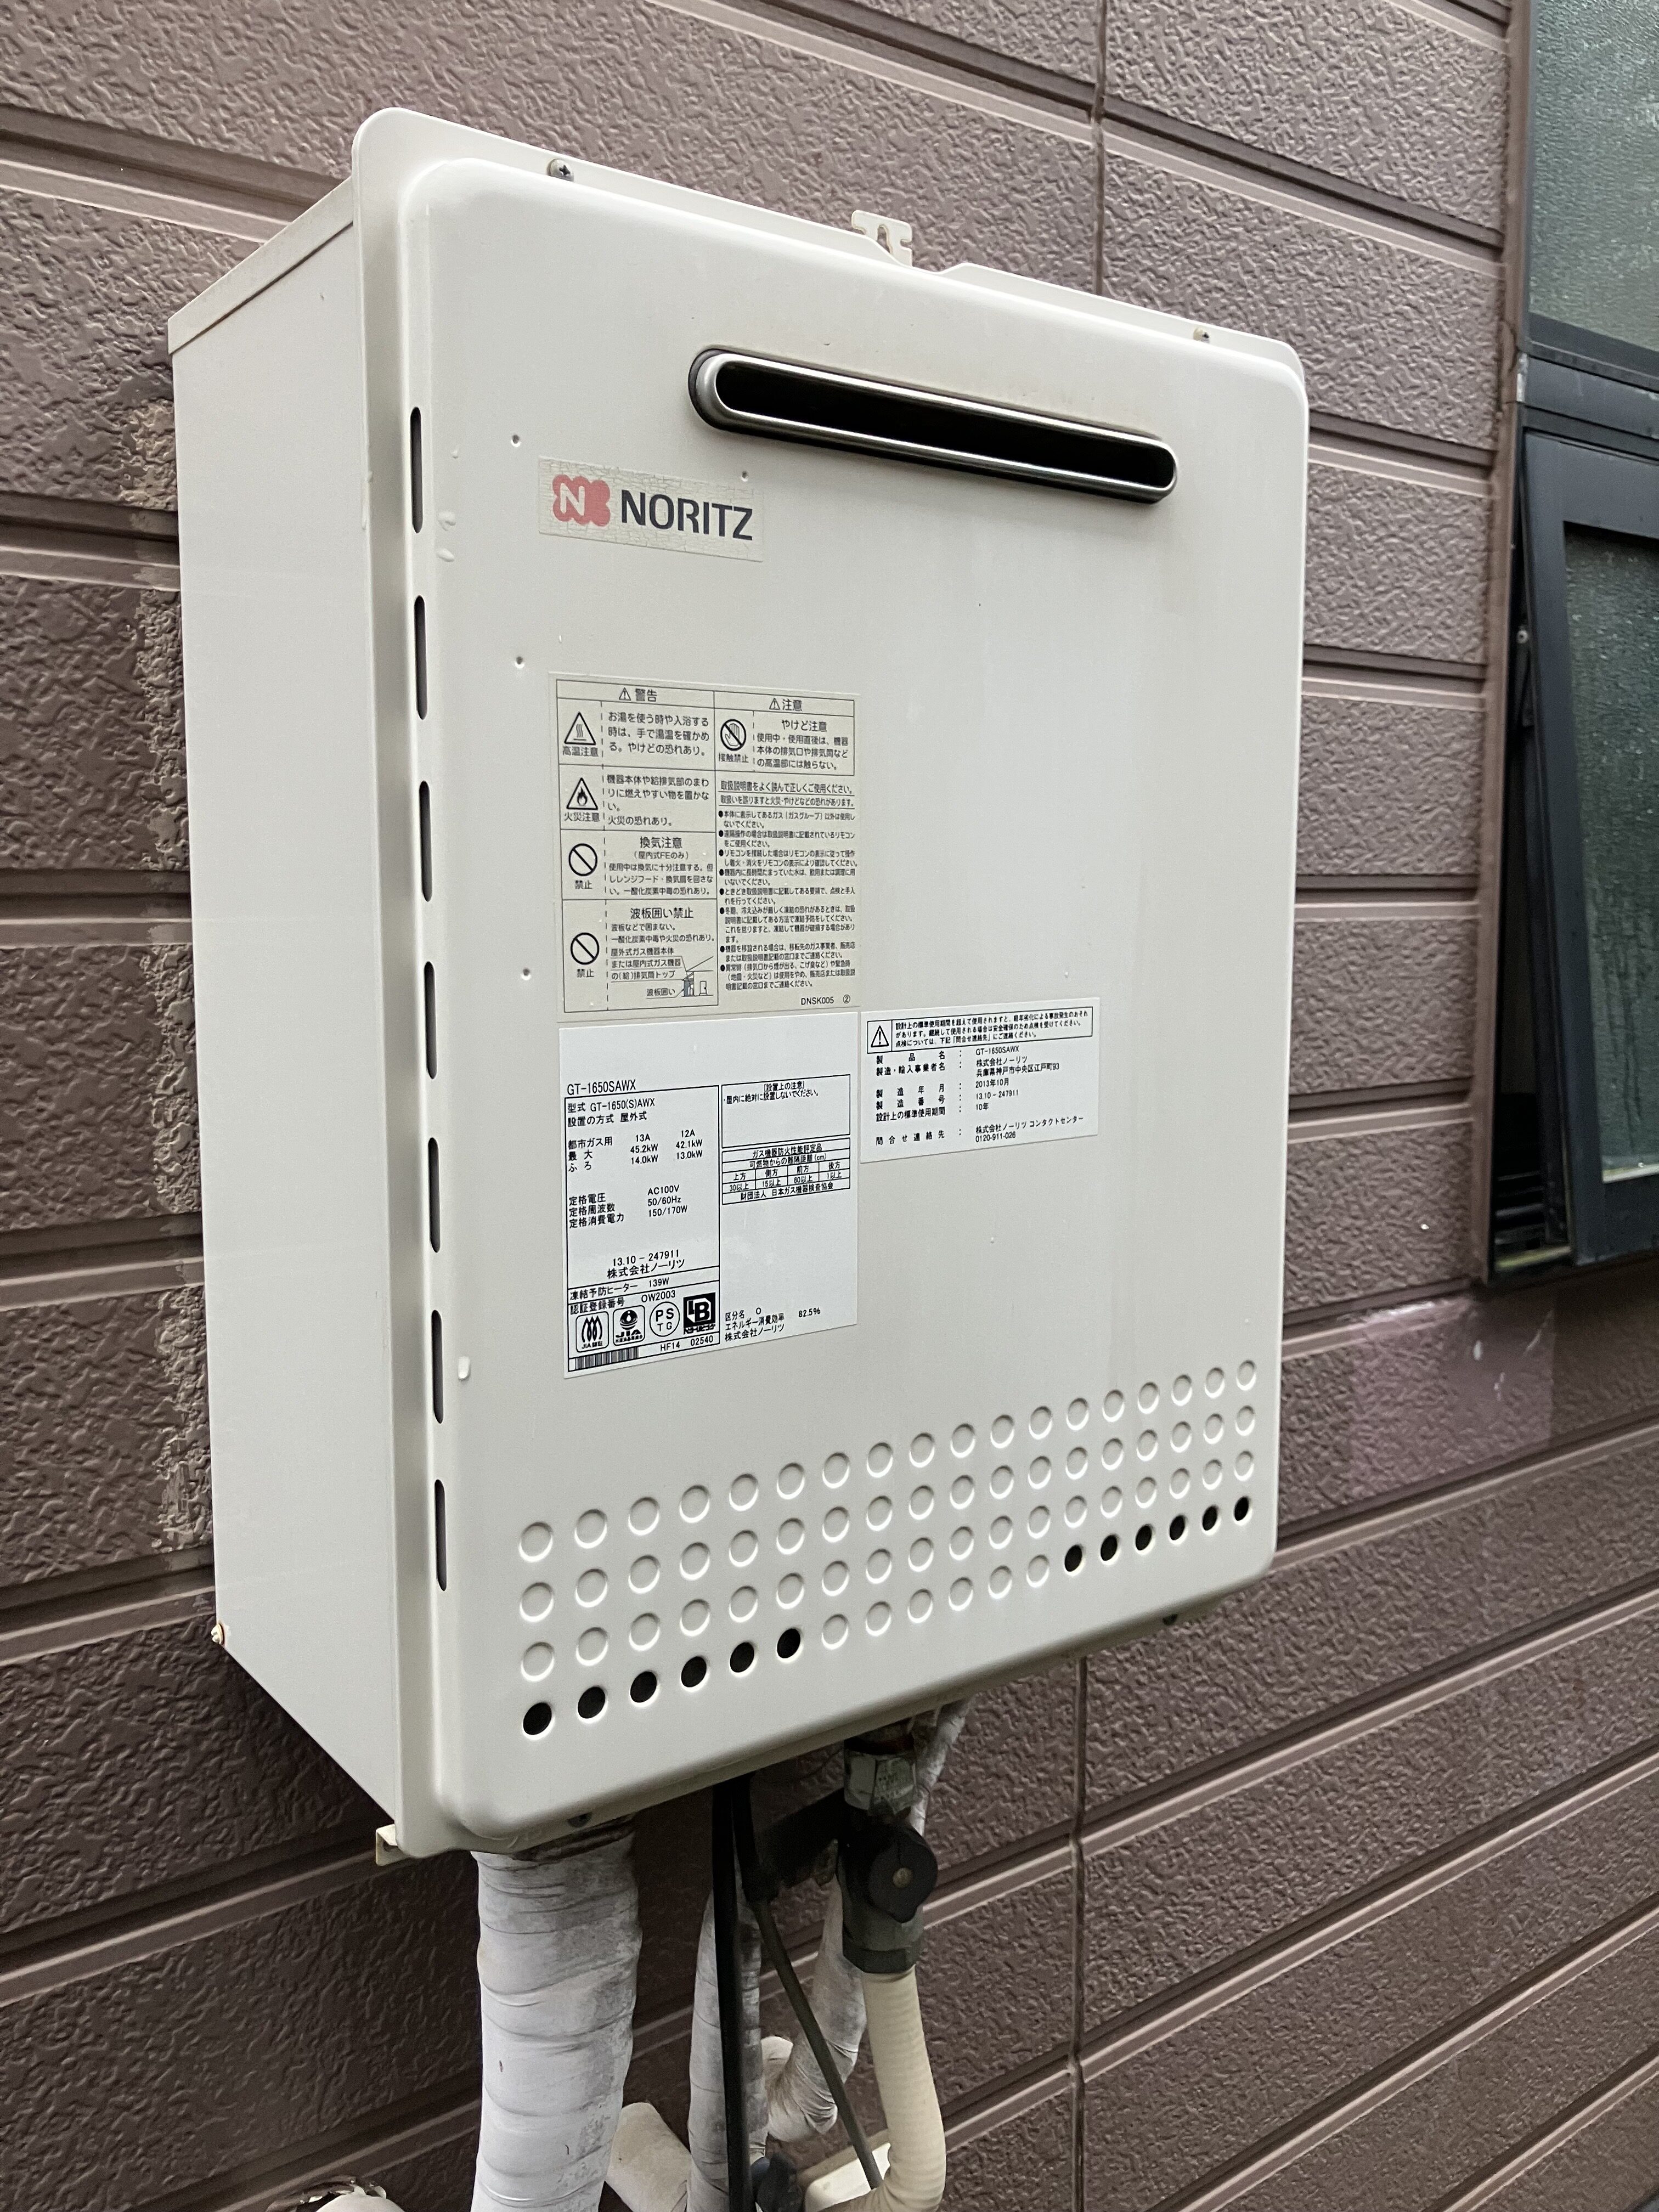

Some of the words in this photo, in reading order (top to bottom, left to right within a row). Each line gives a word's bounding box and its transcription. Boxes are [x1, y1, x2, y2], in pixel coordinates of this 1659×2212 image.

[622, 490, 753, 540] NORITZ
[635, 689, 657, 702] 警告
[782, 698, 803, 712] 注意
[608, 712, 709, 727] お湯を使う時や入浴する
[782, 719, 827, 732] やけど注意
[608, 727, 709, 741] 時は、手で湯温を確かめ
[563, 746, 599, 757] 高温注意
[610, 742, 705, 756] る。やけどの恐れあり。
[719, 753, 749, 763] 接触禁止
[757, 759, 837, 770] の高温部には触らない。
[607, 775, 709, 787] 機器本体や給排気部のまわ
[608, 789, 709, 800] りに燃えやすい物を置かな
[564, 812, 600, 822] 火災注意
[608, 816, 672, 826] 火災の恐れあり。
[640, 837, 682, 849] 換気注意
[575, 880, 593, 890] 禁止
[630, 907, 694, 919] 波板囲い禁止
[611, 923, 676, 932] 波板などで囲まない。
[611, 934, 714, 944] 一酸化炭素中毒や火災の恐れあり。
[611, 947, 674, 957] 屋外式ガス機器本体
[612, 958, 681, 968] または屋内式ガス機器
[577, 968, 595, 978] 禁止
[646, 988, 676, 996] 波板囲い
[801, 996, 834, 1005] DNSK005
[975, 1045, 1019, 1056] GT-1650SAWX
[977, 1056, 1028, 1067] 株式会社ノーリツ
[977, 1063, 1059, 1077] 兵庫県神戸市中央区江戸町93
[567, 1079, 636, 1095] GT-1650SAWX
[975, 1077, 1009, 1088] 2013年10月
[567, 1102, 586, 1114] 型式
[590, 1098, 656, 1111] GT-1650(S)AWX
[568, 1114, 614, 1127] 設置の方式
[620, 1111, 647, 1122] 屋外式
[876, 1107, 945, 1122] 設計上の標準使用期間
[976, 1121, 1026, 1134] 株式会社ノーリツ
[1030, 1116, 1084, 1127] コンタクトセンター
[568, 1136, 613, 1149] 都市ガス用
[636, 1133, 650, 1143] 13A
[681, 1129, 695, 1138] 12A
[975, 1131, 1015, 1142] 0120-911-026
[630, 1144, 658, 1154] 45.2kW
[676, 1139, 703, 1149] 42.1kW
[753, 1143, 822, 1159] ガス機器防火性能評定品
[631, 1154, 658, 1165] 14.0kW
[676, 1150, 703, 1160] 13.0kW
[733, 1172, 747, 1181] 上方
[765, 1169, 778, 1177] 側方
[797, 1165, 810, 1173] 前方
[828, 1161, 840, 1170] 後方
[730, 1182, 749, 1192] 30以上
[762, 1178, 781, 1188] 15以上
[794, 1175, 813, 1183] 60以上
[827, 1170, 842, 1180] 1以上
[569, 1193, 606, 1206] 定格電圧
[647, 1184, 680, 1195] AC100V
[741, 1189, 766, 1201] 財団法人
[772, 1181, 833, 1197] 日本ガス機器検査協会
[569, 1203, 616, 1218] 定格周波数
[648, 1196, 681, 1207] 50/60Hz
[569, 1213, 624, 1229] 定格消費電力
[648, 1205, 688, 1217] 150/170W
[607, 1259, 685, 1279] 株式会社ノーリツ
[570, 1283, 638, 1300] 凍結予防ヒーター
[649, 1277, 669, 1288] 139W
[570, 1296, 625, 1315] 認証登録番号
[641, 1290, 676, 1303] OW2003
[725, 1310, 744, 1322] 区分名
[725, 1313, 785, 1331] エネルギー消費効率
[798, 1307, 821, 1318] 82.5%
[615, 1329, 642, 1339] JIA
[725, 1323, 785, 1342] 株式会社ノーリツ
[661, 1343, 680, 1352] HF14
[690, 1335, 714, 1346] 02540
